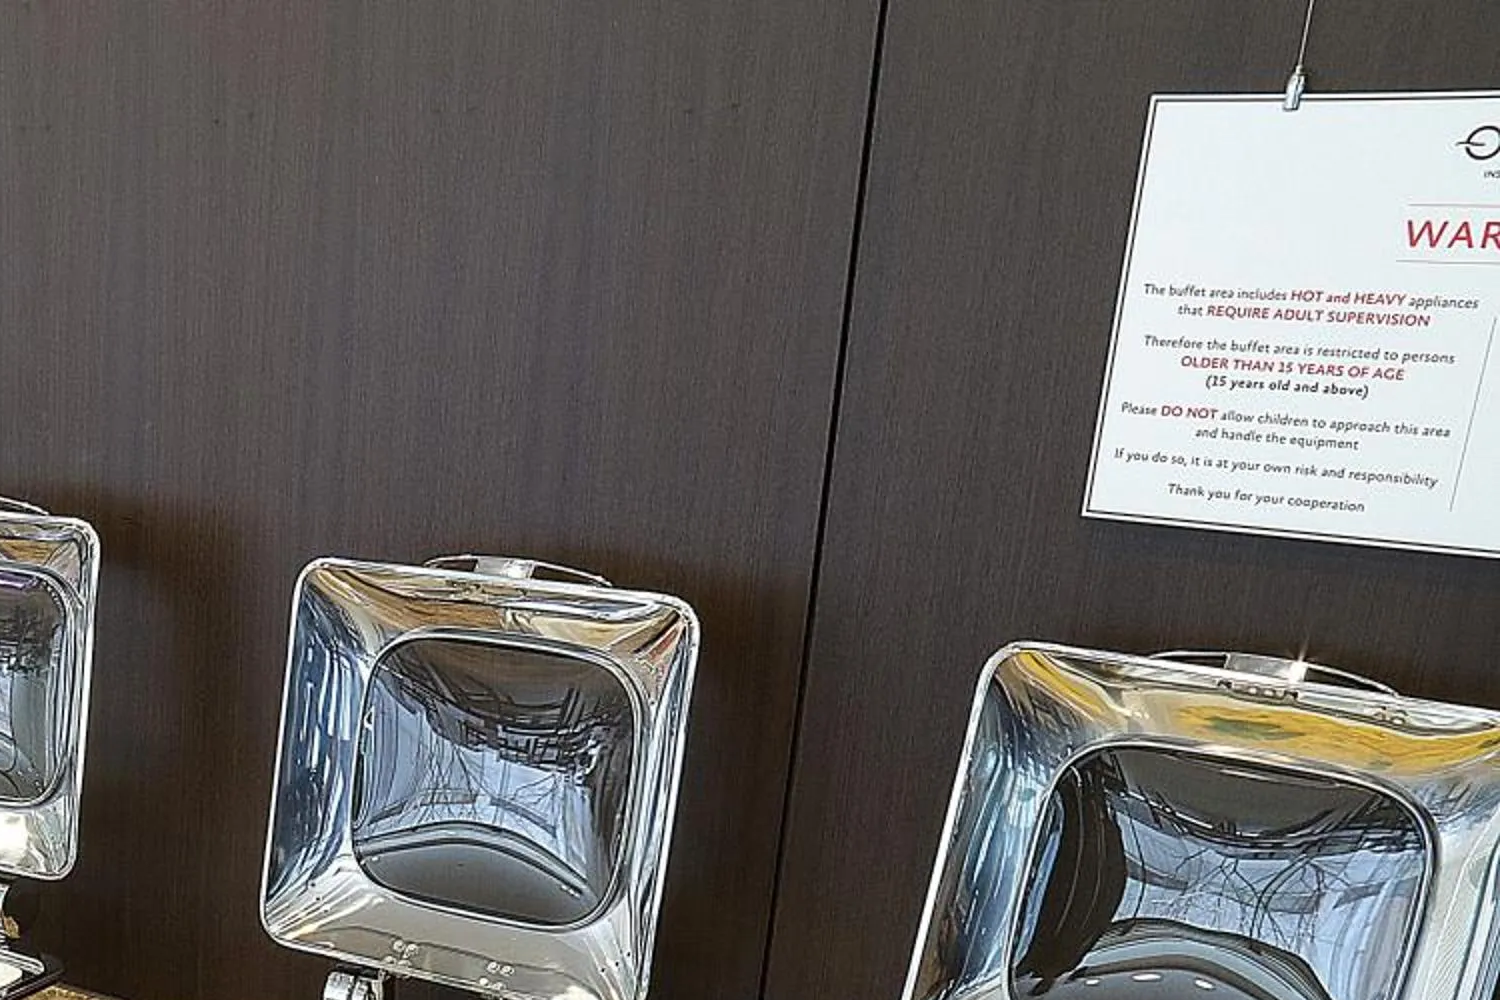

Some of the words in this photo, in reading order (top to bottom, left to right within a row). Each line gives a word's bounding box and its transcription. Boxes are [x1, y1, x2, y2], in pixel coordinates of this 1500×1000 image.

[1407, 219, 1500, 249] WAR
[1144, 283, 1165, 296] The
[1169, 284, 1206, 297] buffet
[1209, 288, 1235, 299] area
[1237, 288, 1287, 301] includes
[1291, 290, 1324, 302] HOT
[1326, 292, 1351, 304] and
[1353, 293, 1407, 306] HEAVY
[1408, 295, 1480, 310] appliances
[1177, 304, 1203, 316] that
[1206, 305, 1270, 319] REQUIRE
[1273, 308, 1324, 321] ADULT
[1326, 310, 1431, 327] SUPERVISION
[1144, 335, 1203, 349] Therefore
[1207, 339, 1227, 351] the
[1230, 340, 1270, 353] buffet
[1273, 345, 1300, 355] area
[1304, 345, 1314, 356] is
[1317, 346, 1381, 361] restricted
[1384, 351, 1399, 362] to
[1401, 353, 1455, 365] persons
[1181, 355, 1229, 370] OLDER
[1233, 359, 1275, 373] THAN
[1278, 362, 1293, 373] 15
[1298, 363, 1345, 377] YEARS
[1347, 366, 1370, 378] OF
[1372, 367, 1406, 381] AGE
[1205, 375, 1227, 389] (15
[1229, 379, 1264, 390] years
[1268, 380, 1290, 391] old
[1294, 382, 1319, 393] and
[1323, 384, 1369, 399] above)
[1121, 402, 1157, 416] Please
[1161, 405, 1183, 417] DO
[1186, 407, 1218, 420] NOT
[1220, 410, 1255, 423] allow
[1257, 413, 1308, 426] children
[1313, 418, 1326, 429] to
[1329, 420, 1391, 433] approach
[1394, 423, 1418, 435] this
[1422, 427, 1451, 437] area
[1196, 428, 1218, 439] and
[1221, 428, 1262, 443] handle
[1266, 432, 1286, 445] the
[1289, 436, 1359, 450] equipment
[1114, 448, 1124, 459] If
[1126, 451, 1148, 462] you
[1152, 452, 1168, 463] do
[1171, 455, 1187, 467] so,
[1190, 455, 1200, 467] it
[1203, 457, 1213, 467] is
[1216, 458, 1229, 469] at
[1231, 460, 1260, 472] your
[1263, 463, 1291, 474] own
[1295, 464, 1317, 476] risk
[1321, 467, 1345, 479] and
[1348, 471, 1439, 490] responsibility
[1168, 483, 1204, 497] Thank
[1207, 489, 1230, 500] you
[1233, 490, 1252, 502] for
[1255, 494, 1284, 506] your
[1287, 496, 1365, 512] cooperation
